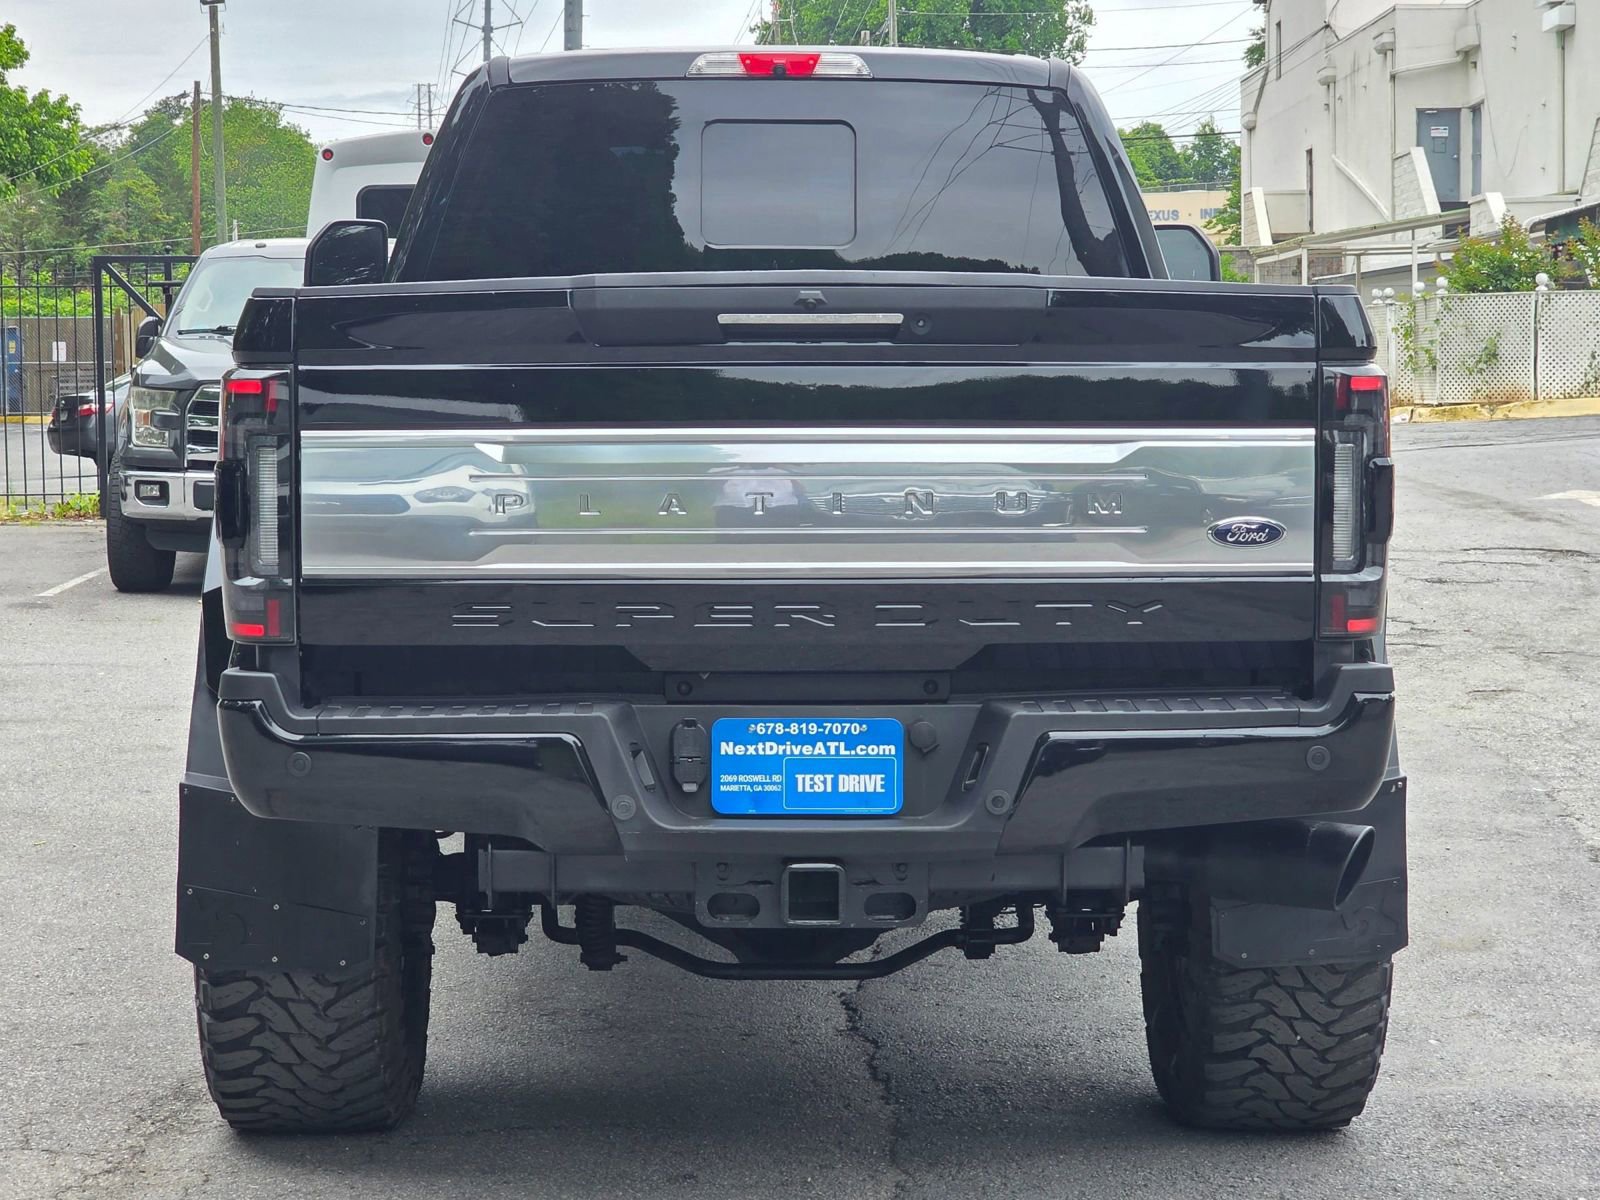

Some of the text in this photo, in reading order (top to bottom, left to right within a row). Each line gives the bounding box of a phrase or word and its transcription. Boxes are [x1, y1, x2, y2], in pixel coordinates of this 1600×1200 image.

[494, 490, 1123, 515] PLATINUM
[1227, 523, 1269, 542] Ford
[756, 722, 860, 735] 678-819-7070
[720, 741, 896, 755] NextDriveATL.com
[720, 774, 782, 783] 2069 ROSWELL RD
[795, 774, 886, 793] TEST DRIVE
[720, 784, 753, 793] MARIETTA,
[753, 784, 762, 792] GA
